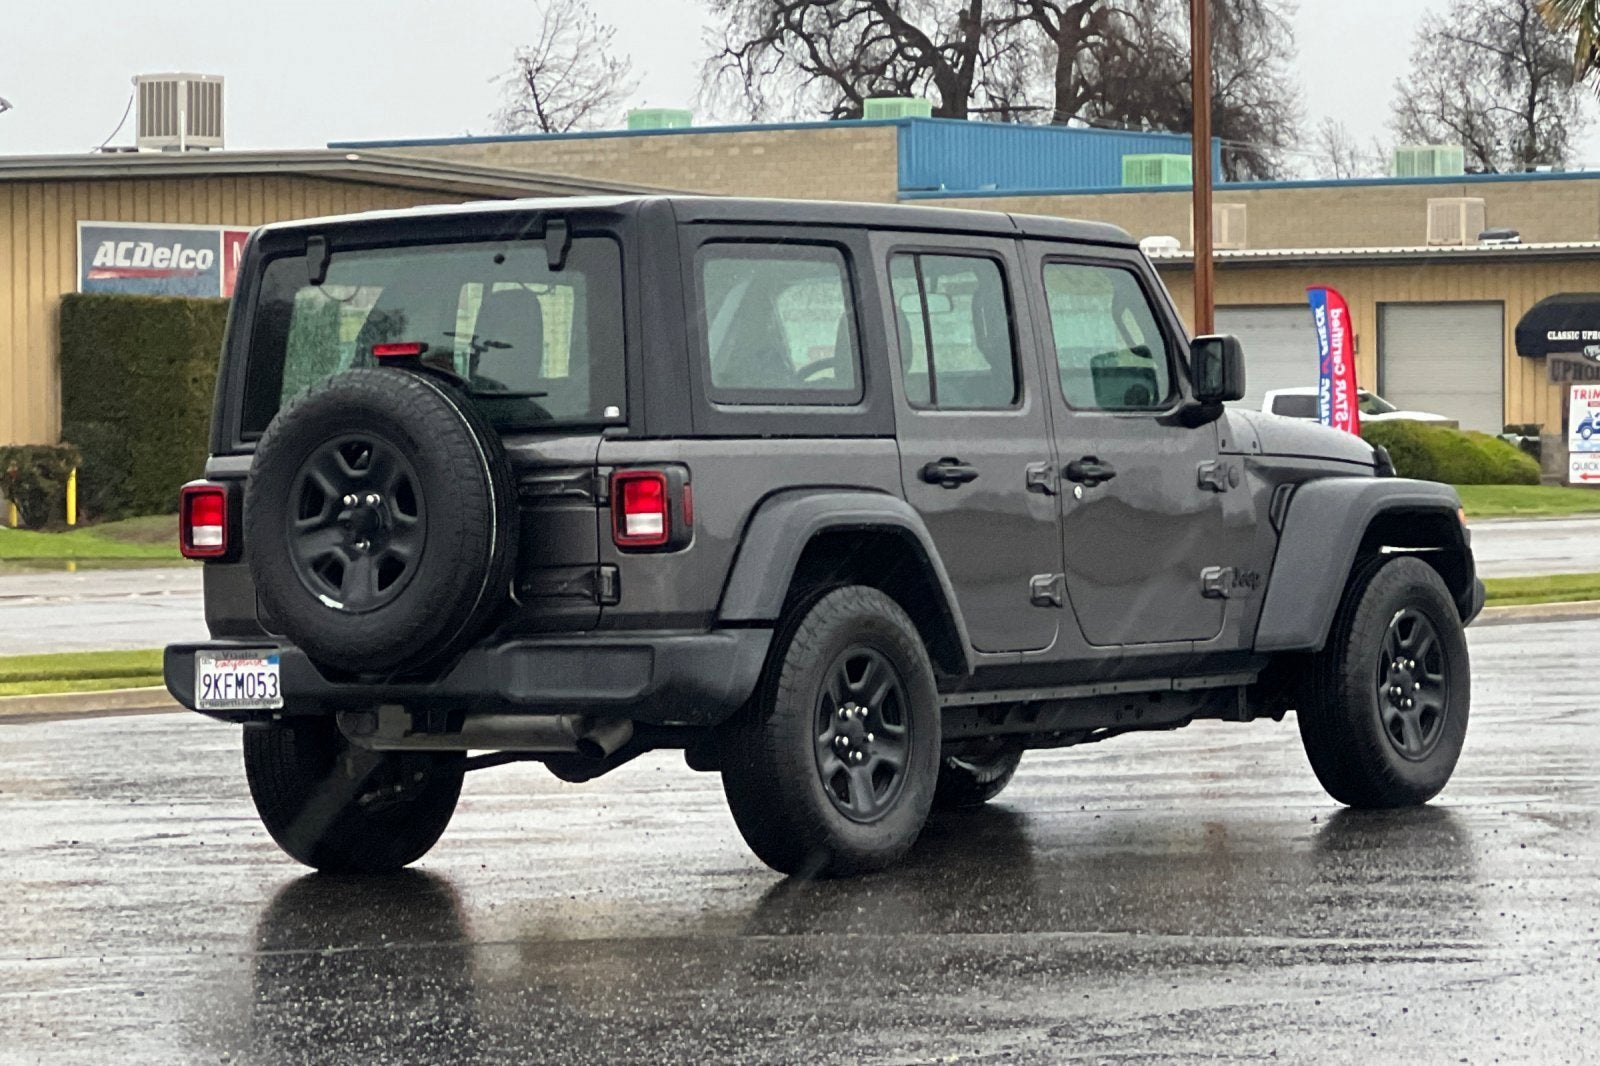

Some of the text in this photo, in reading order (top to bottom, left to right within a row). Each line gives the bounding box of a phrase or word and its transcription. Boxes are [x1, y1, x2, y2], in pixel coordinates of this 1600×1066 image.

[92, 241, 214, 270] ACDelco
[1547, 330, 1580, 340] CLASSIC
[1232, 566, 1259, 590] Jeep
[202, 672, 278, 700] 9KFM053
